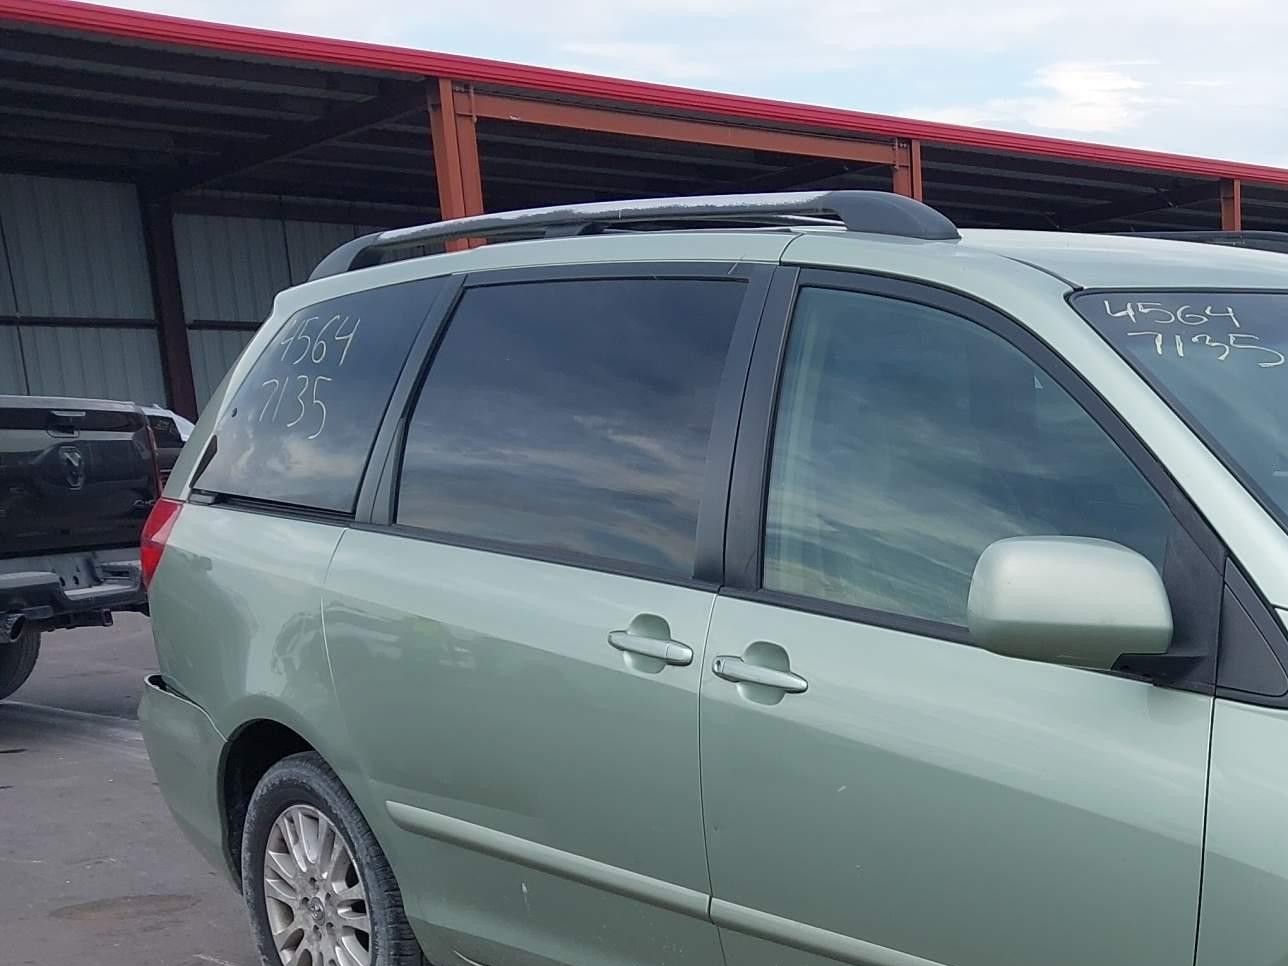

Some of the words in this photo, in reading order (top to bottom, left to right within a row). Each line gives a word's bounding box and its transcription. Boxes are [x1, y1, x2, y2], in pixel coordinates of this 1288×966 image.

[1103, 299, 1240, 328] 4564
[1126, 331, 1286, 368] 7135
[257, 374, 333, 440] 7135
